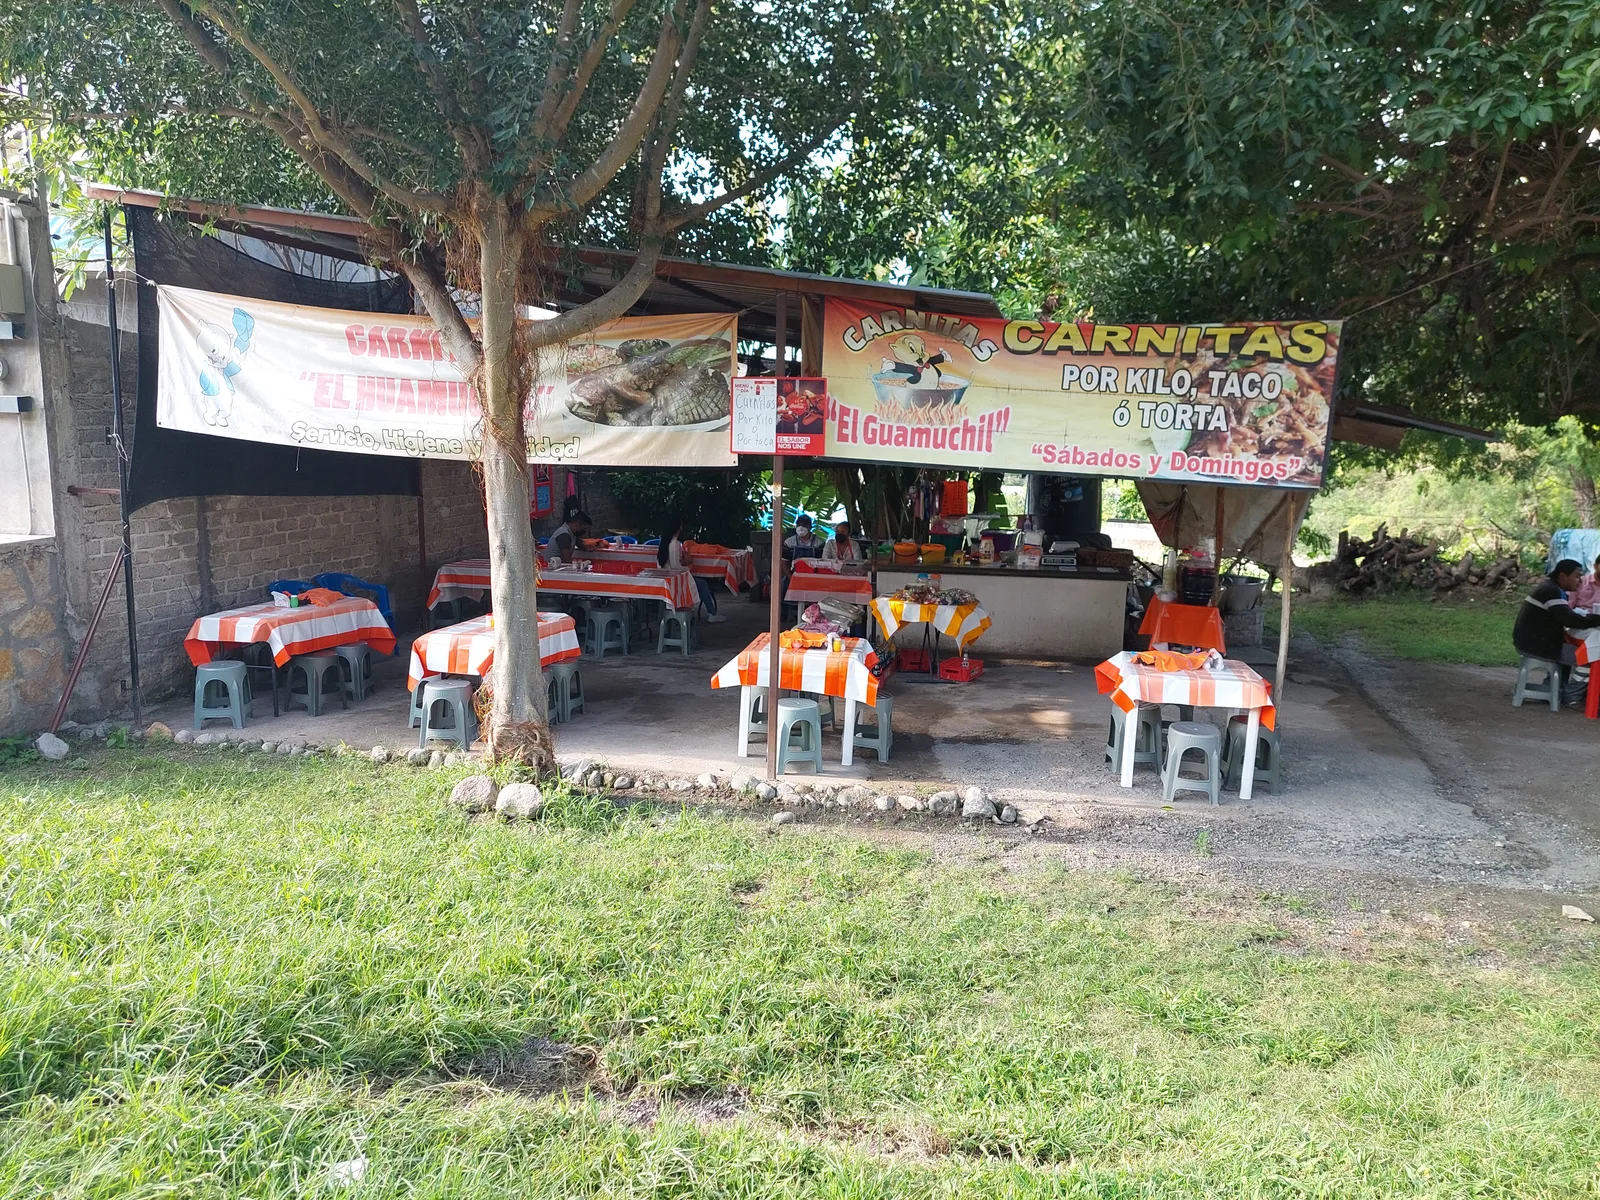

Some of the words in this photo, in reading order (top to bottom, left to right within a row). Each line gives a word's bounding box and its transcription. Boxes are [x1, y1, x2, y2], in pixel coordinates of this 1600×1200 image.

[344, 323, 457, 362] CARNI
[843, 309, 999, 362] CARNITAS
[1003, 320, 1329, 366] CARNITAS
[1062, 364, 1118, 393] POR
[1125, 367, 1199, 401] KILO,
[1208, 370, 1282, 400] TACO
[738, 412, 753, 425] Por
[1137, 402, 1228, 432] TORTA
[290, 421, 381, 452] Servicio,
[381, 429, 463, 457] Higiene
[526, 436, 580, 459] idad
[737, 432, 751, 446] Por
[1148, 454, 1163, 475] y
